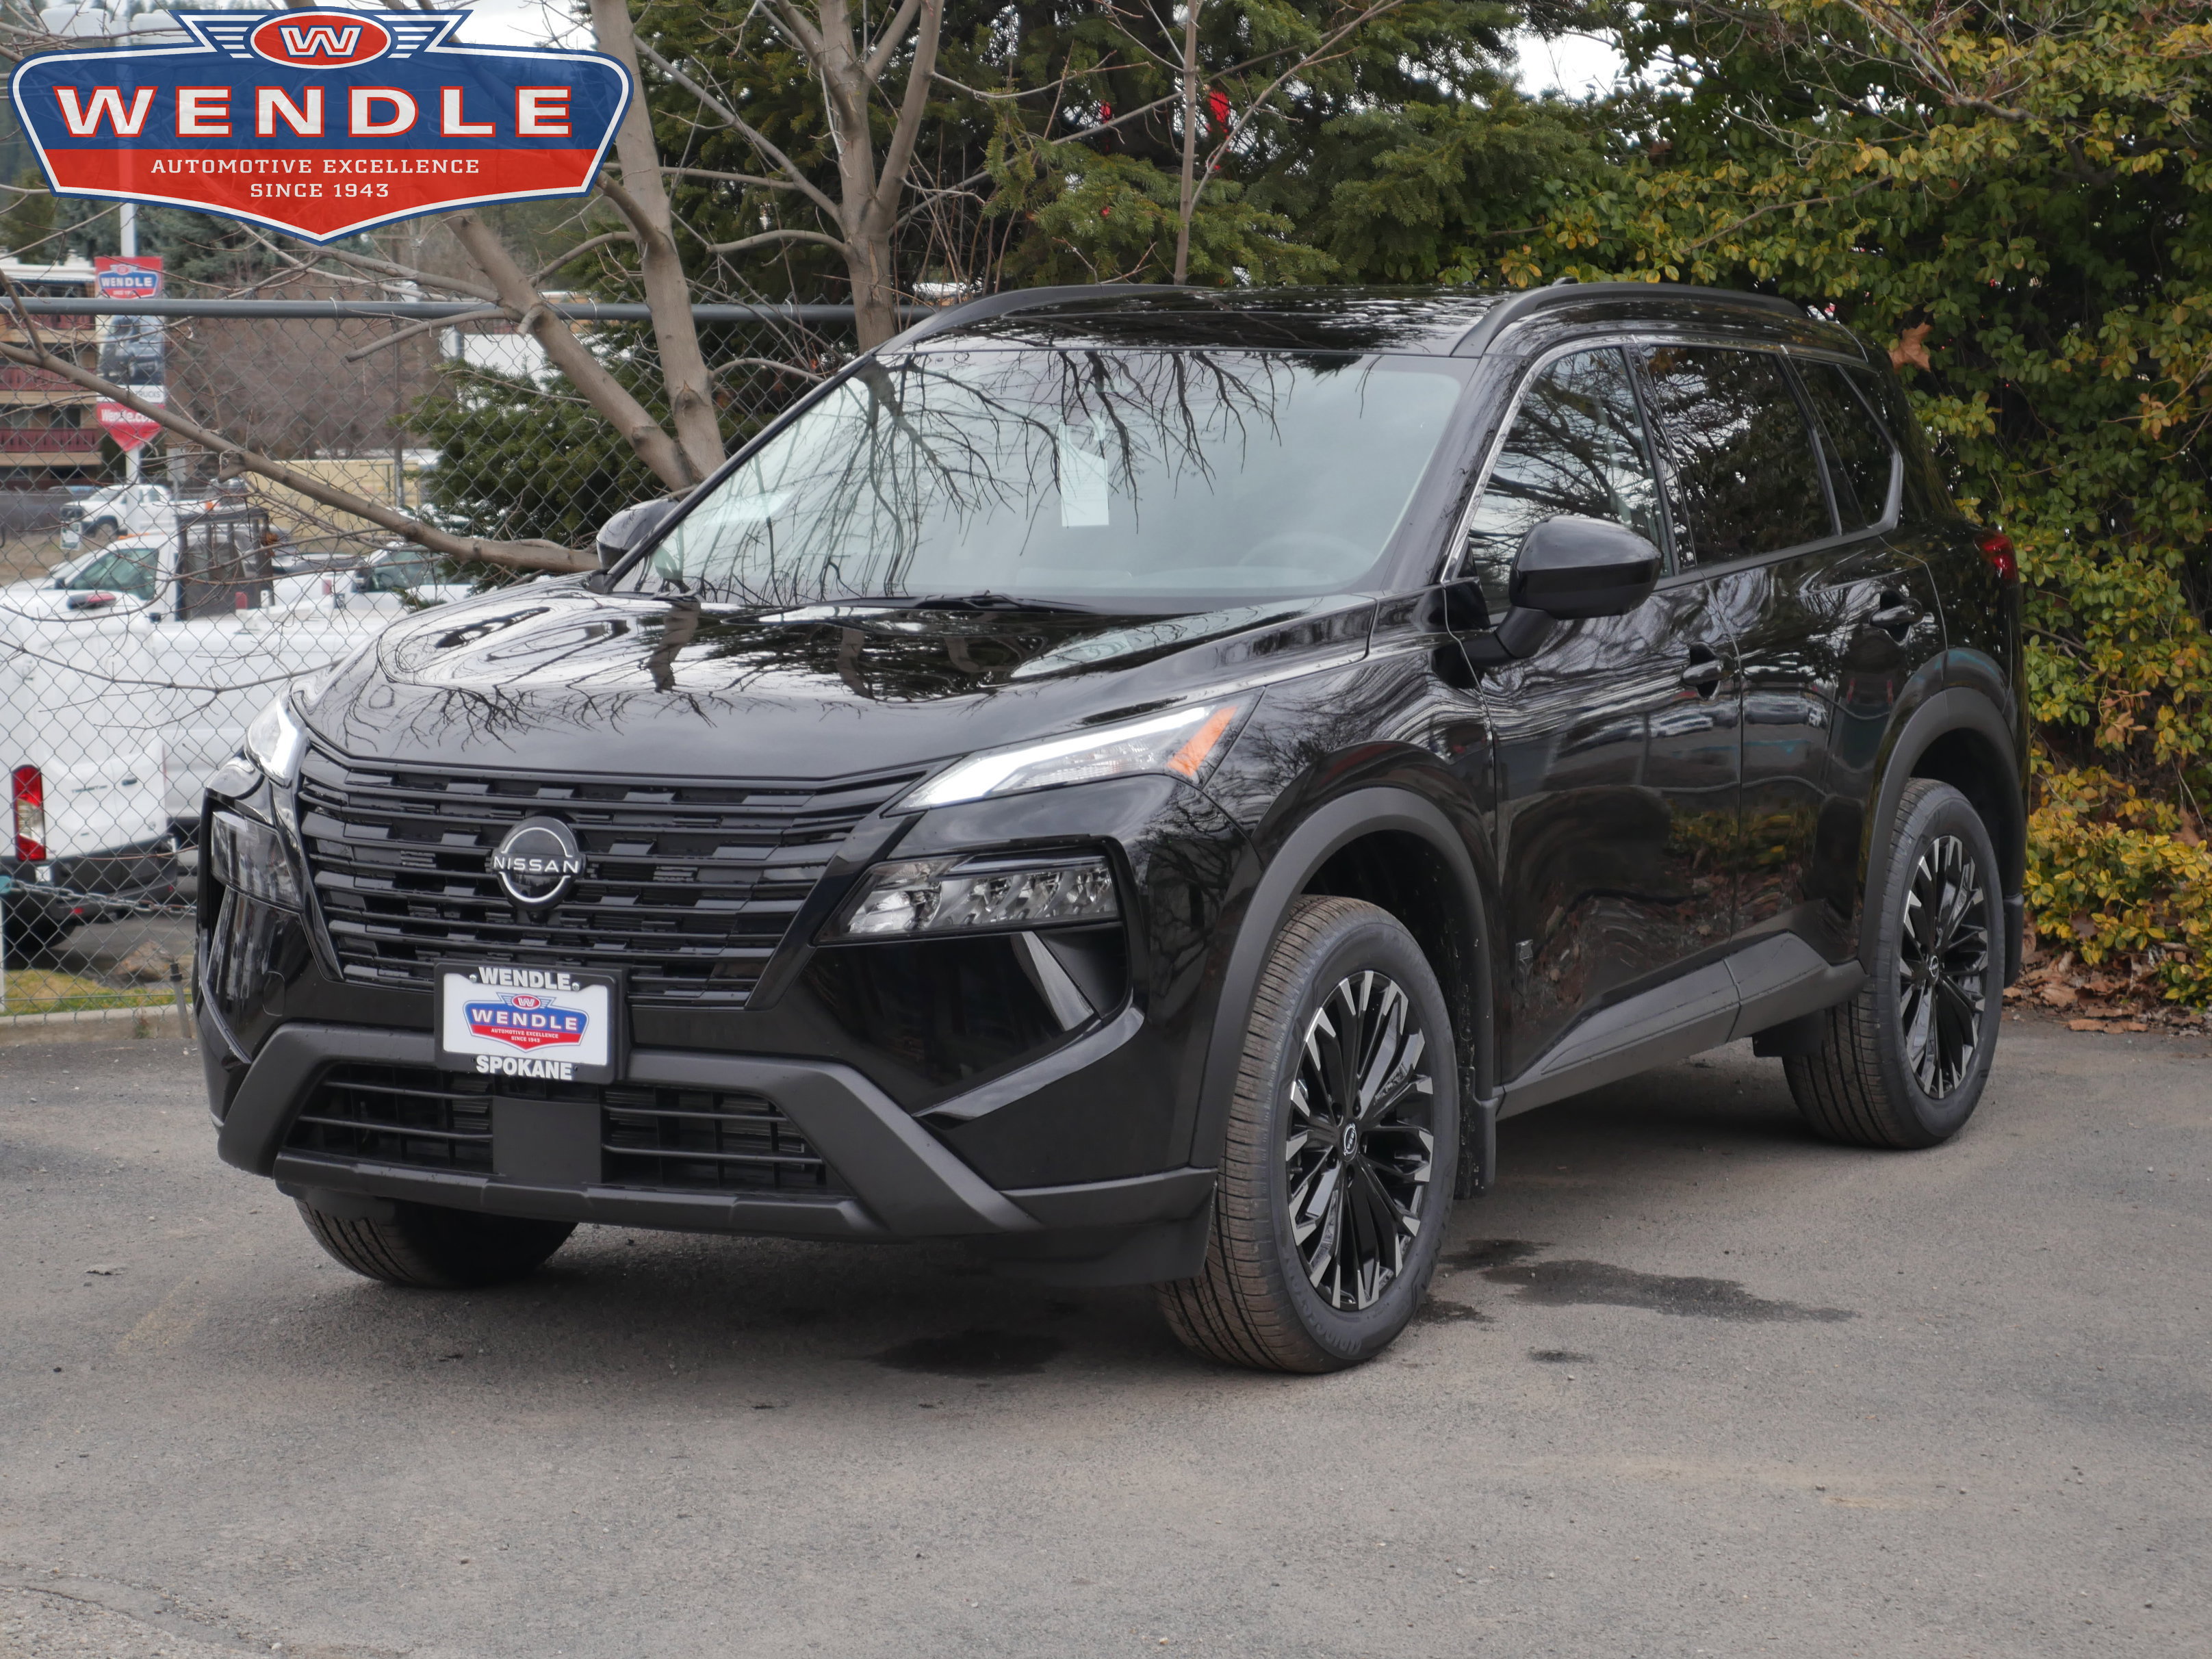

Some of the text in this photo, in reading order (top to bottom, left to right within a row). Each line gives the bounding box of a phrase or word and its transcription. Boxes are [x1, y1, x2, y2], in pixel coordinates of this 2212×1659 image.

[101, 276, 153, 287] WENDLE
[493, 856, 579, 874] NISSAN
[478, 966, 572, 991] WENDLE
[472, 1008, 578, 1031] WENDLE
[476, 1055, 572, 1081] SPOKANE
